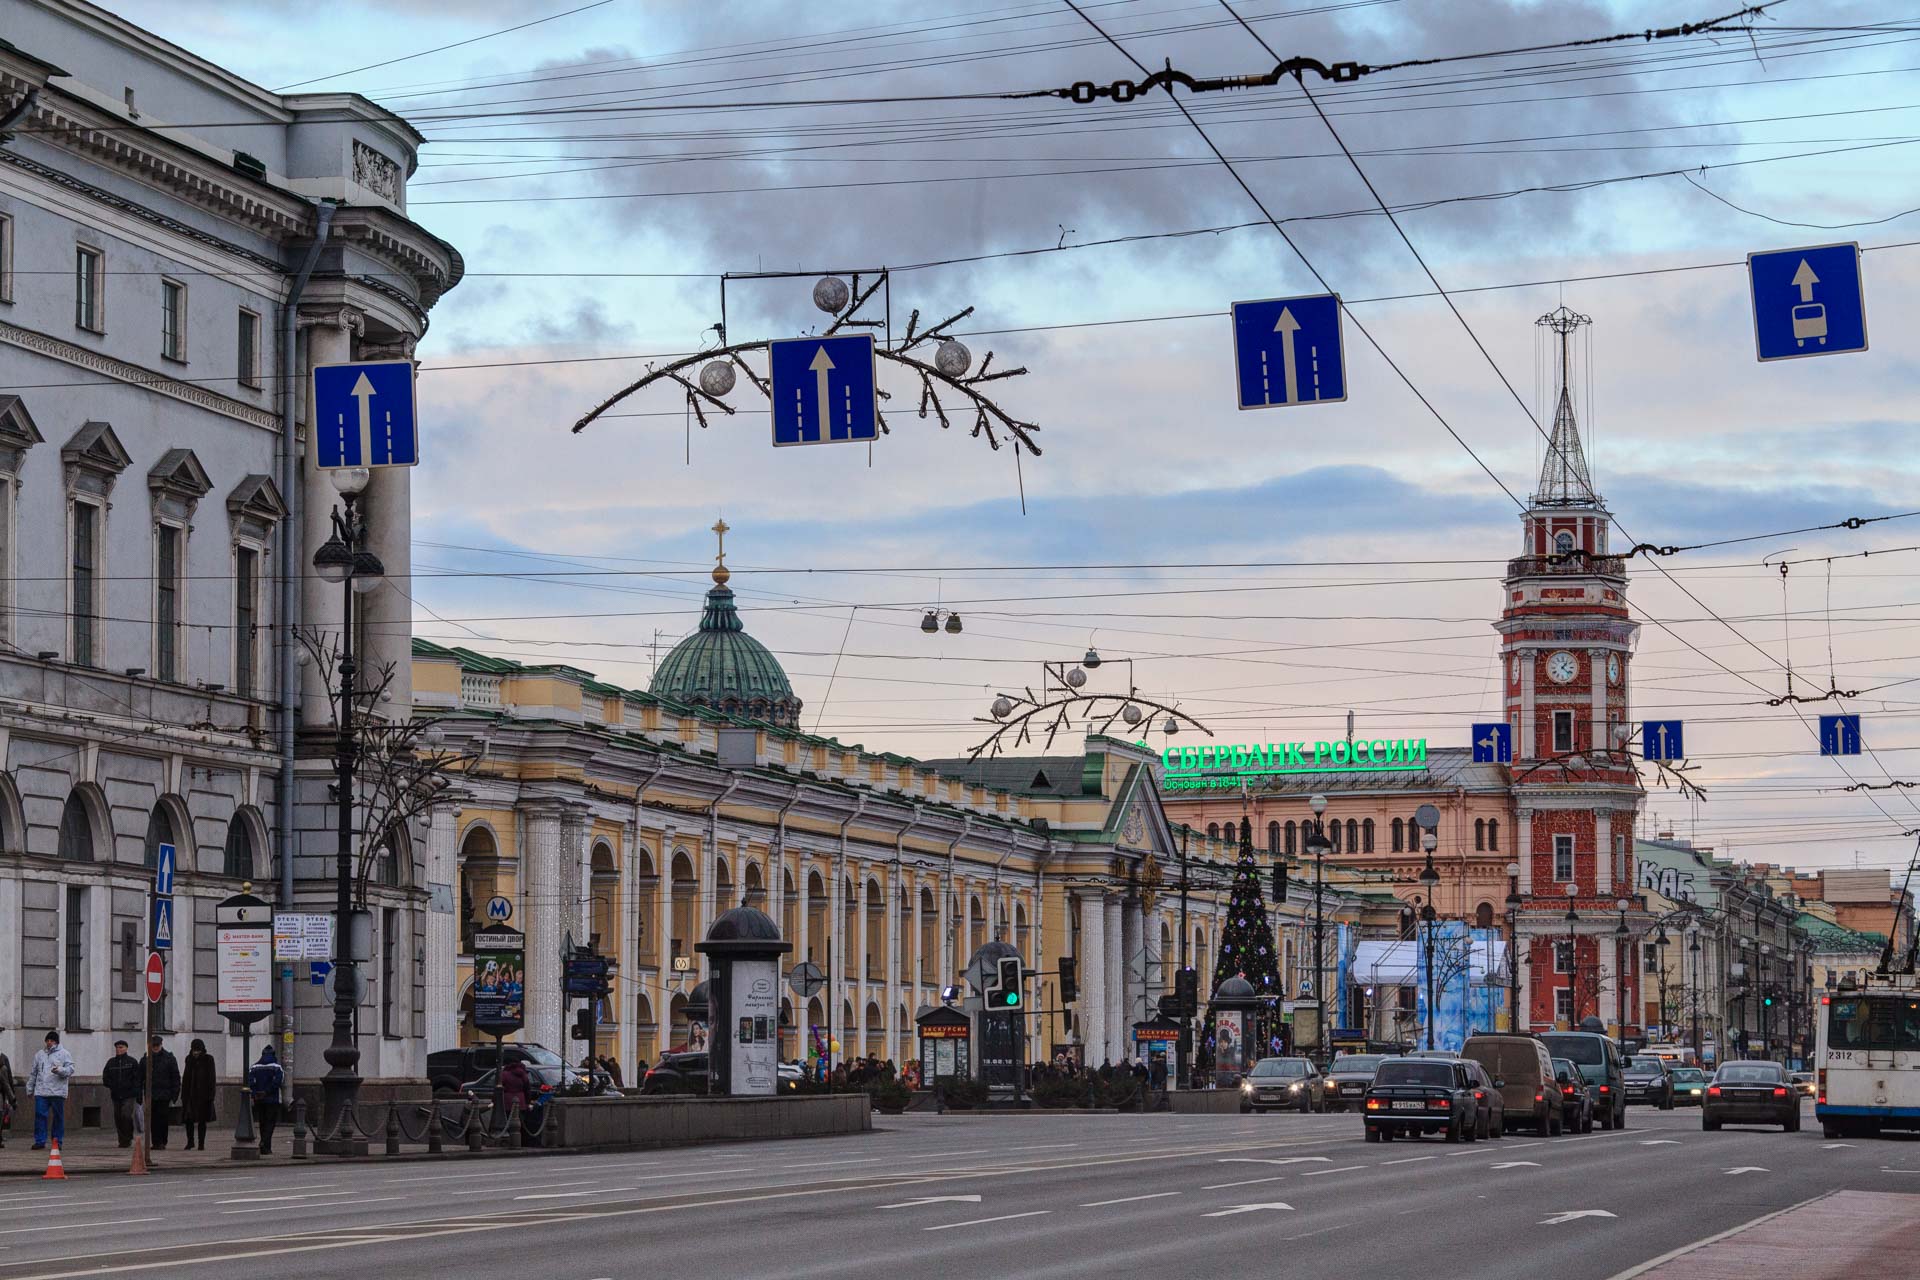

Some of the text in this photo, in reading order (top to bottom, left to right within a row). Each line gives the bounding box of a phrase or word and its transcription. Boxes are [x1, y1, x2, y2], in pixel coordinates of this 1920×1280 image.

[1161, 738, 1428, 770] СБЕРБАНК РОССИИ
[1163, 779, 1208, 790] Основан
[1210, 780, 1216, 788] в
[1218, 776, 1242, 788] 1841
[490, 900, 507, 917] М
[475, 935, 523, 943] ГОСТИНЫЙ ДВОР
[1828, 1051, 1853, 1061] 2312
